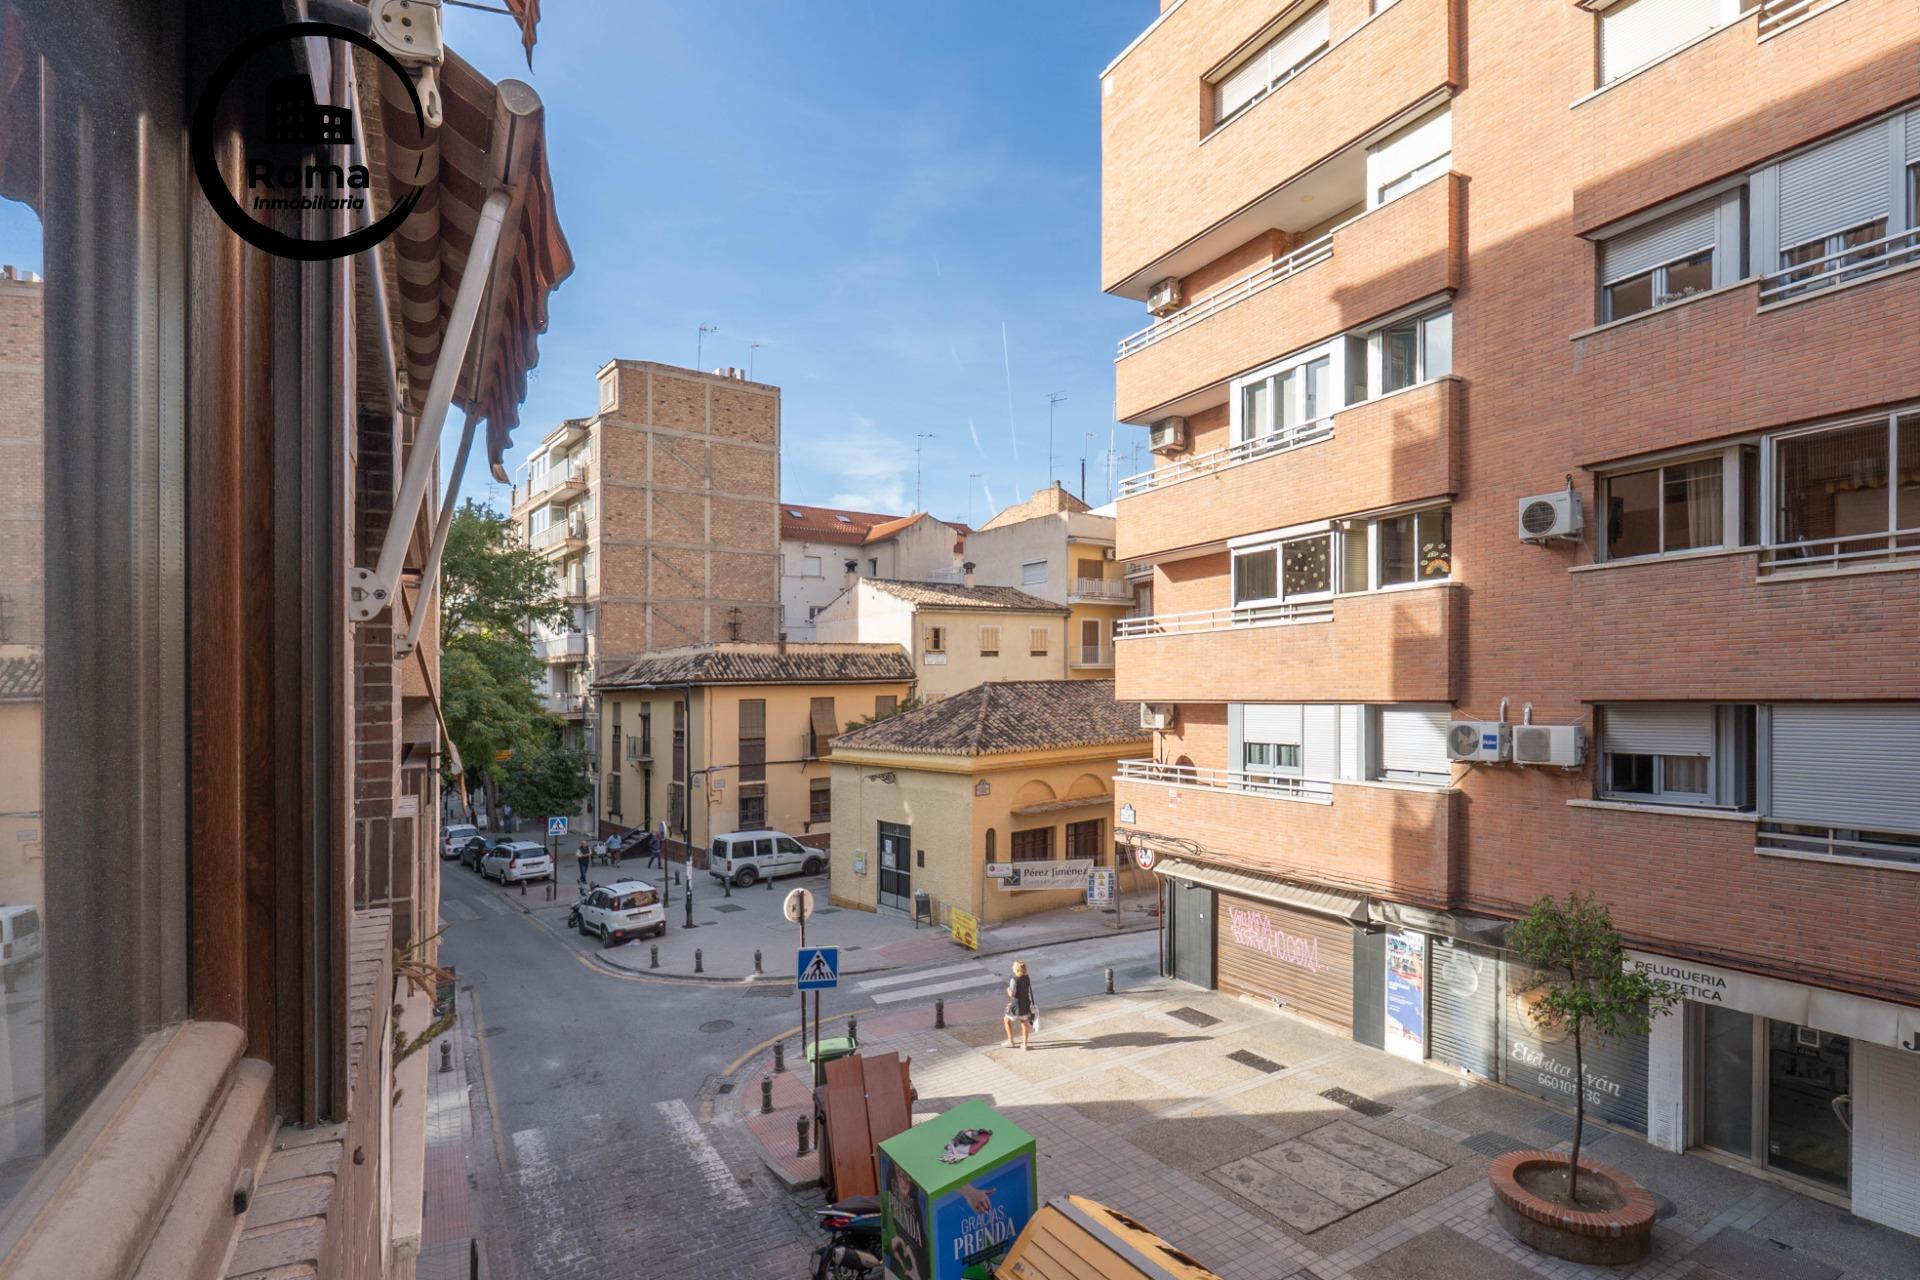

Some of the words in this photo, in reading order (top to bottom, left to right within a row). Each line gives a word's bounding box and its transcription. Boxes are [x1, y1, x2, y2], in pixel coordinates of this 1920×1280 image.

[1023, 867, 1049, 877] Pérez
[1051, 866, 1088, 878] Jiménez
[1634, 960, 1727, 989] PELUQUERIA
[1537, 1072, 1601, 1105] 66010136
[953, 1216, 1017, 1261] PRENDA
